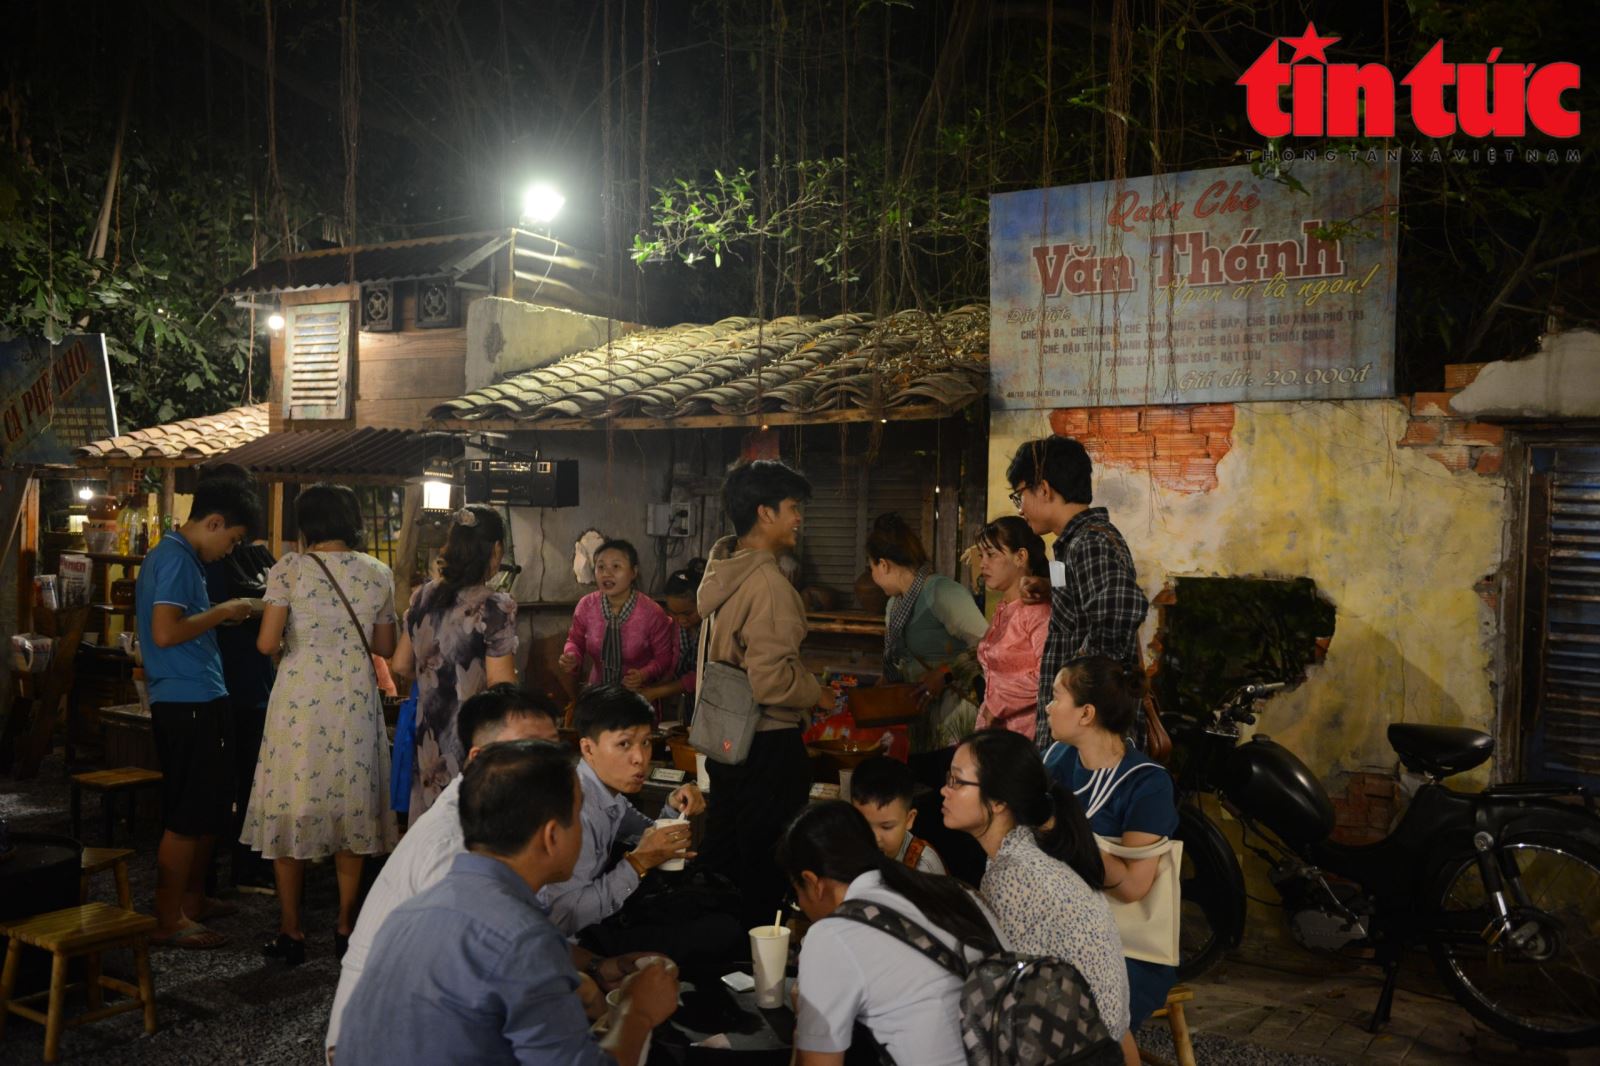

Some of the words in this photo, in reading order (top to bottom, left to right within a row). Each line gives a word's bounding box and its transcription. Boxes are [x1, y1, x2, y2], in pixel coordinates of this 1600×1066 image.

[1193, 180, 1261, 219] Chè
[1033, 242, 1137, 297] Văn
[1149, 219, 1346, 290] Thánh
[1297, 263, 1380, 307] ngon!
